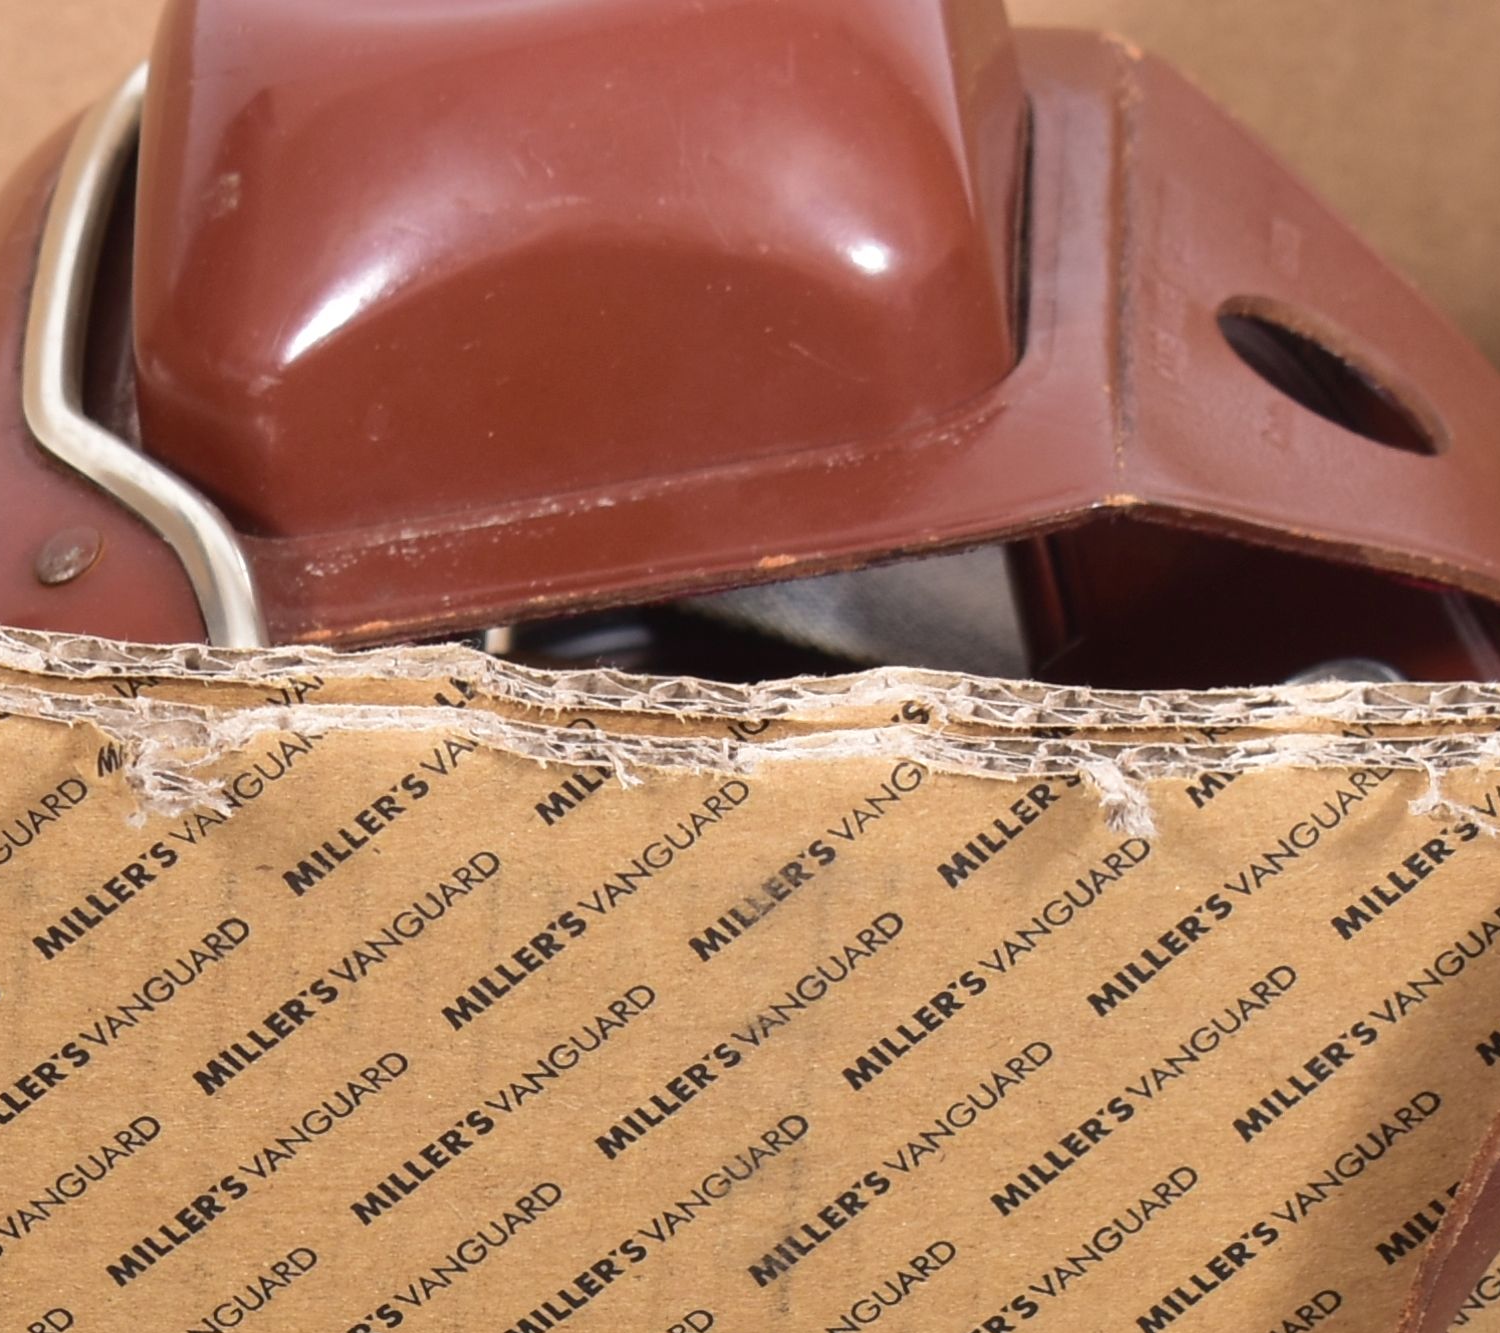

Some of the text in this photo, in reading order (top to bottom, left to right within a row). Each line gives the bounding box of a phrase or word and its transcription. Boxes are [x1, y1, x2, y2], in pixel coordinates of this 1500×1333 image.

[78, 917, 250, 1046] VANGUARD
[192, 851, 500, 1096] MILLER'S VANGUARD
[441, 780, 749, 1031] MILLER'S VANGUARD
[841, 839, 1151, 1091] MILLER'S VANGUARD
[747, 1041, 1053, 1288] MILLER'S VANGUARD
[990, 965, 1297, 1217] MILLER'S VANGUARD
[1232, 1021, 1378, 1143] MILLER'S
[1270, 1091, 1442, 1223] VANGUARD
[393, 1182, 562, 1307] VANGUARD
[637, 1114, 809, 1243] VANGUARD
